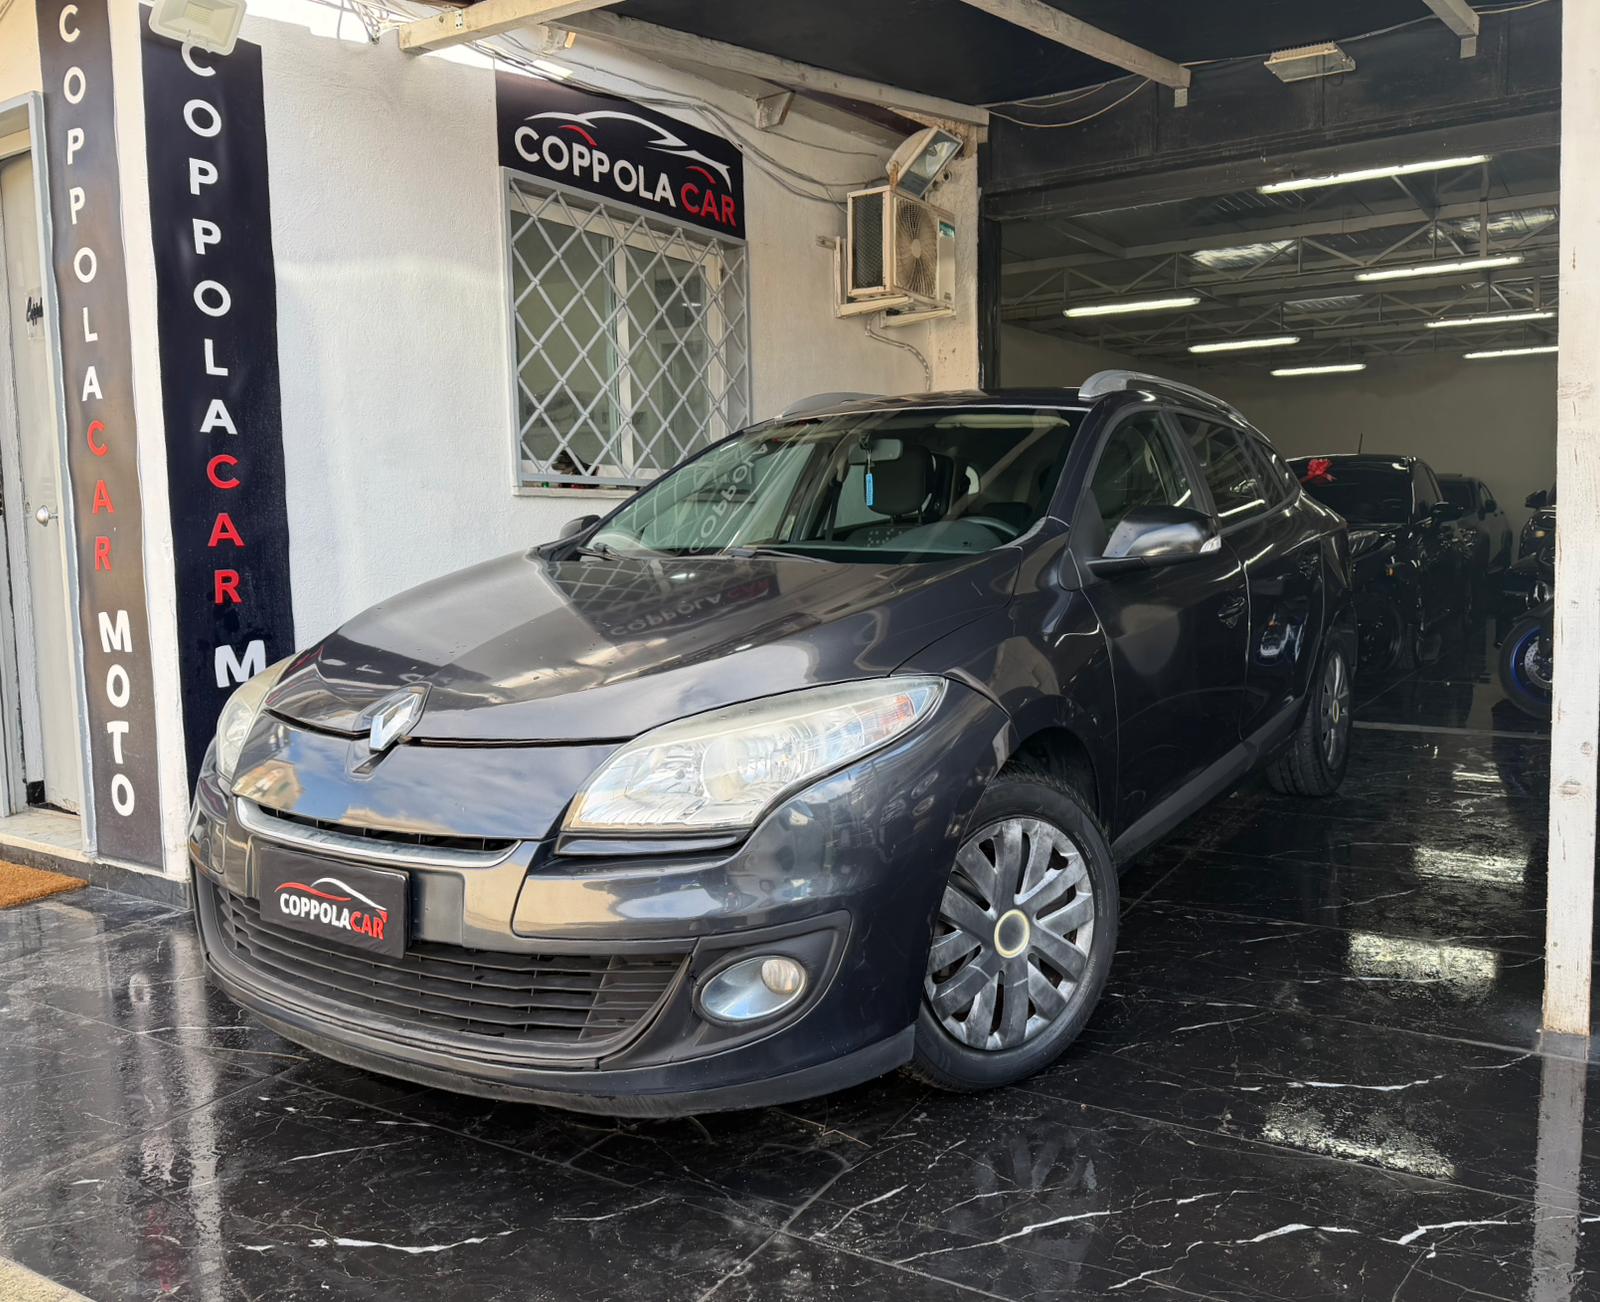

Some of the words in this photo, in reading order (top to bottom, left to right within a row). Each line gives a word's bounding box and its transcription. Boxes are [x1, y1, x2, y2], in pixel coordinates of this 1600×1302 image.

[514, 125, 676, 208] COPPOLA
[680, 182, 737, 227] CAR
[97, 609, 135, 817] MOTO
